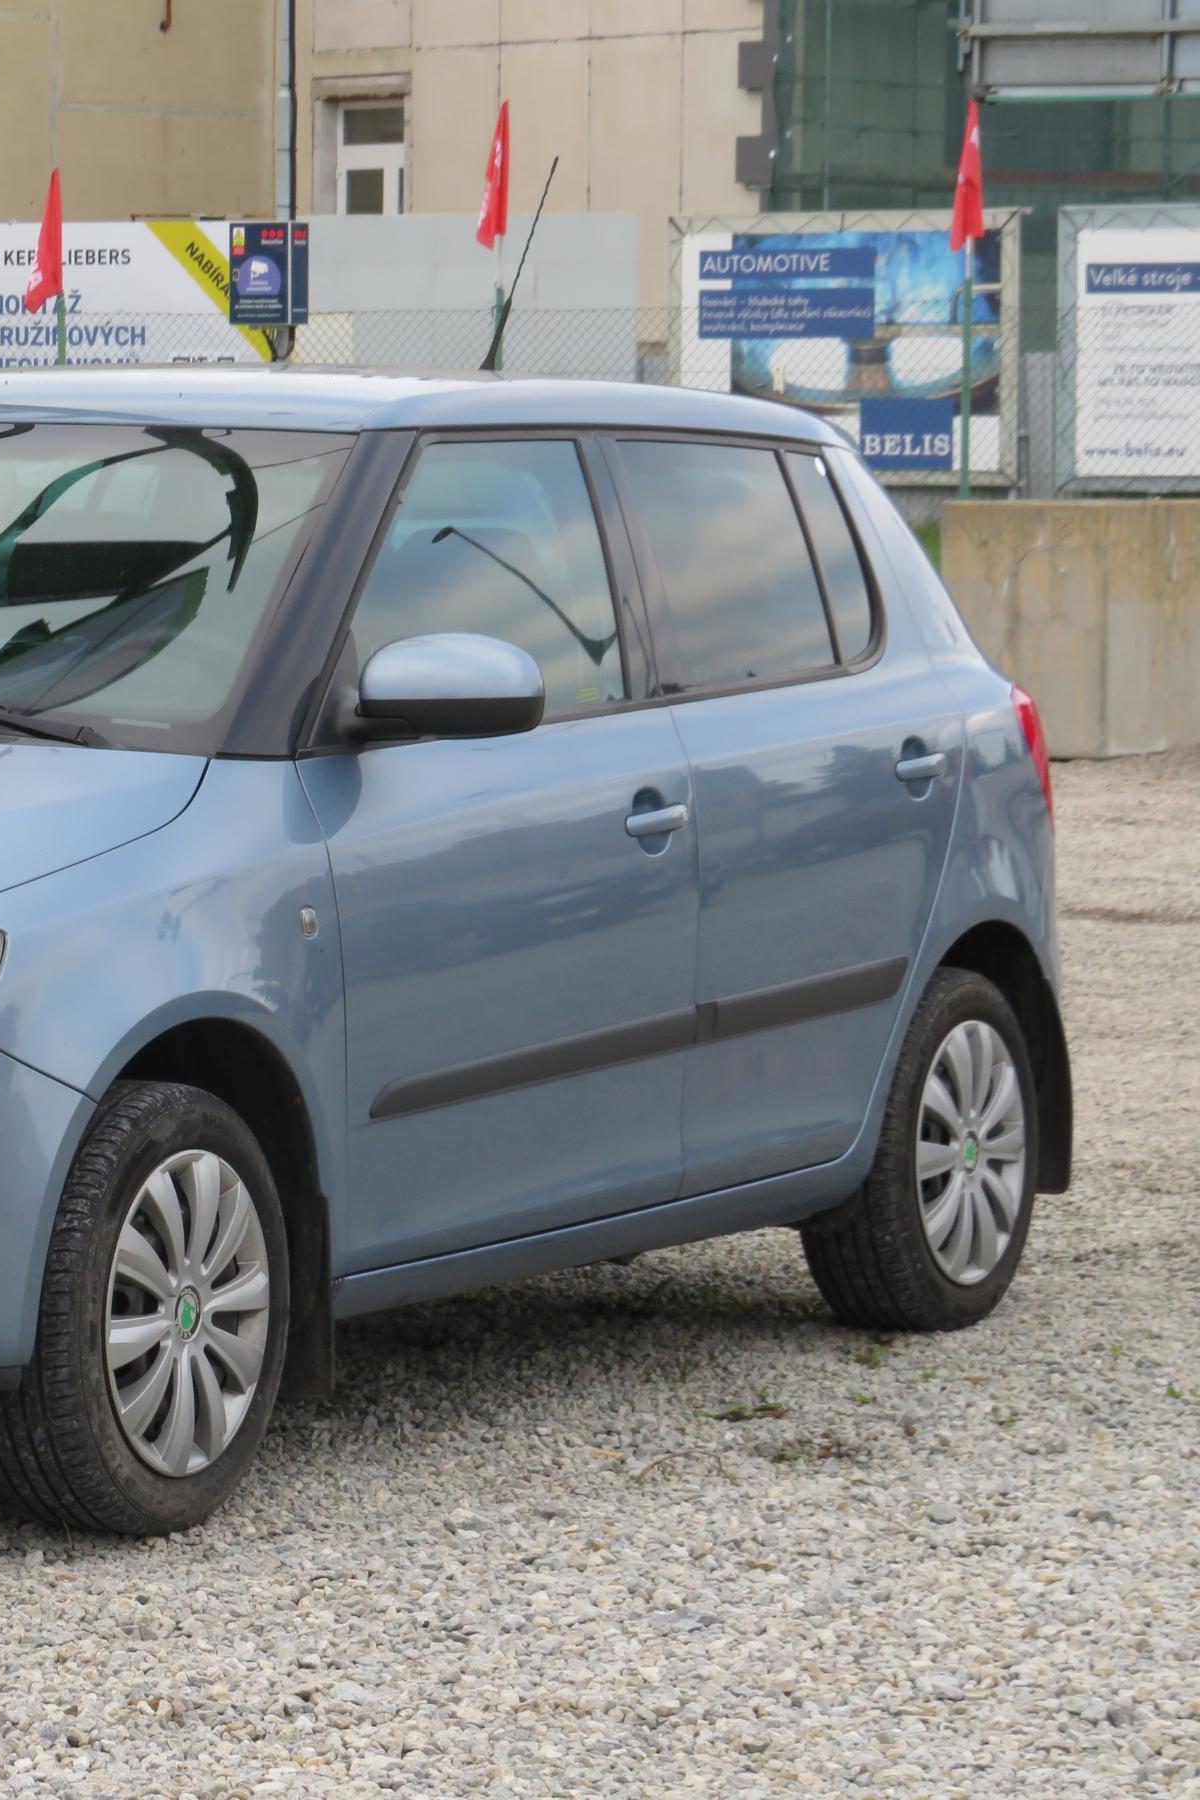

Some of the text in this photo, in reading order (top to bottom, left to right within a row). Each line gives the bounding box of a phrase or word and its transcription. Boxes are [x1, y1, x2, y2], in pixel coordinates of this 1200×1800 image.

[62, 249, 131, 265] IEBERS
[703, 253, 831, 273] AUTOMOTIVE
[1089, 266, 1192, 293] Velké stroje
[862, 433, 951, 456] BELIS
